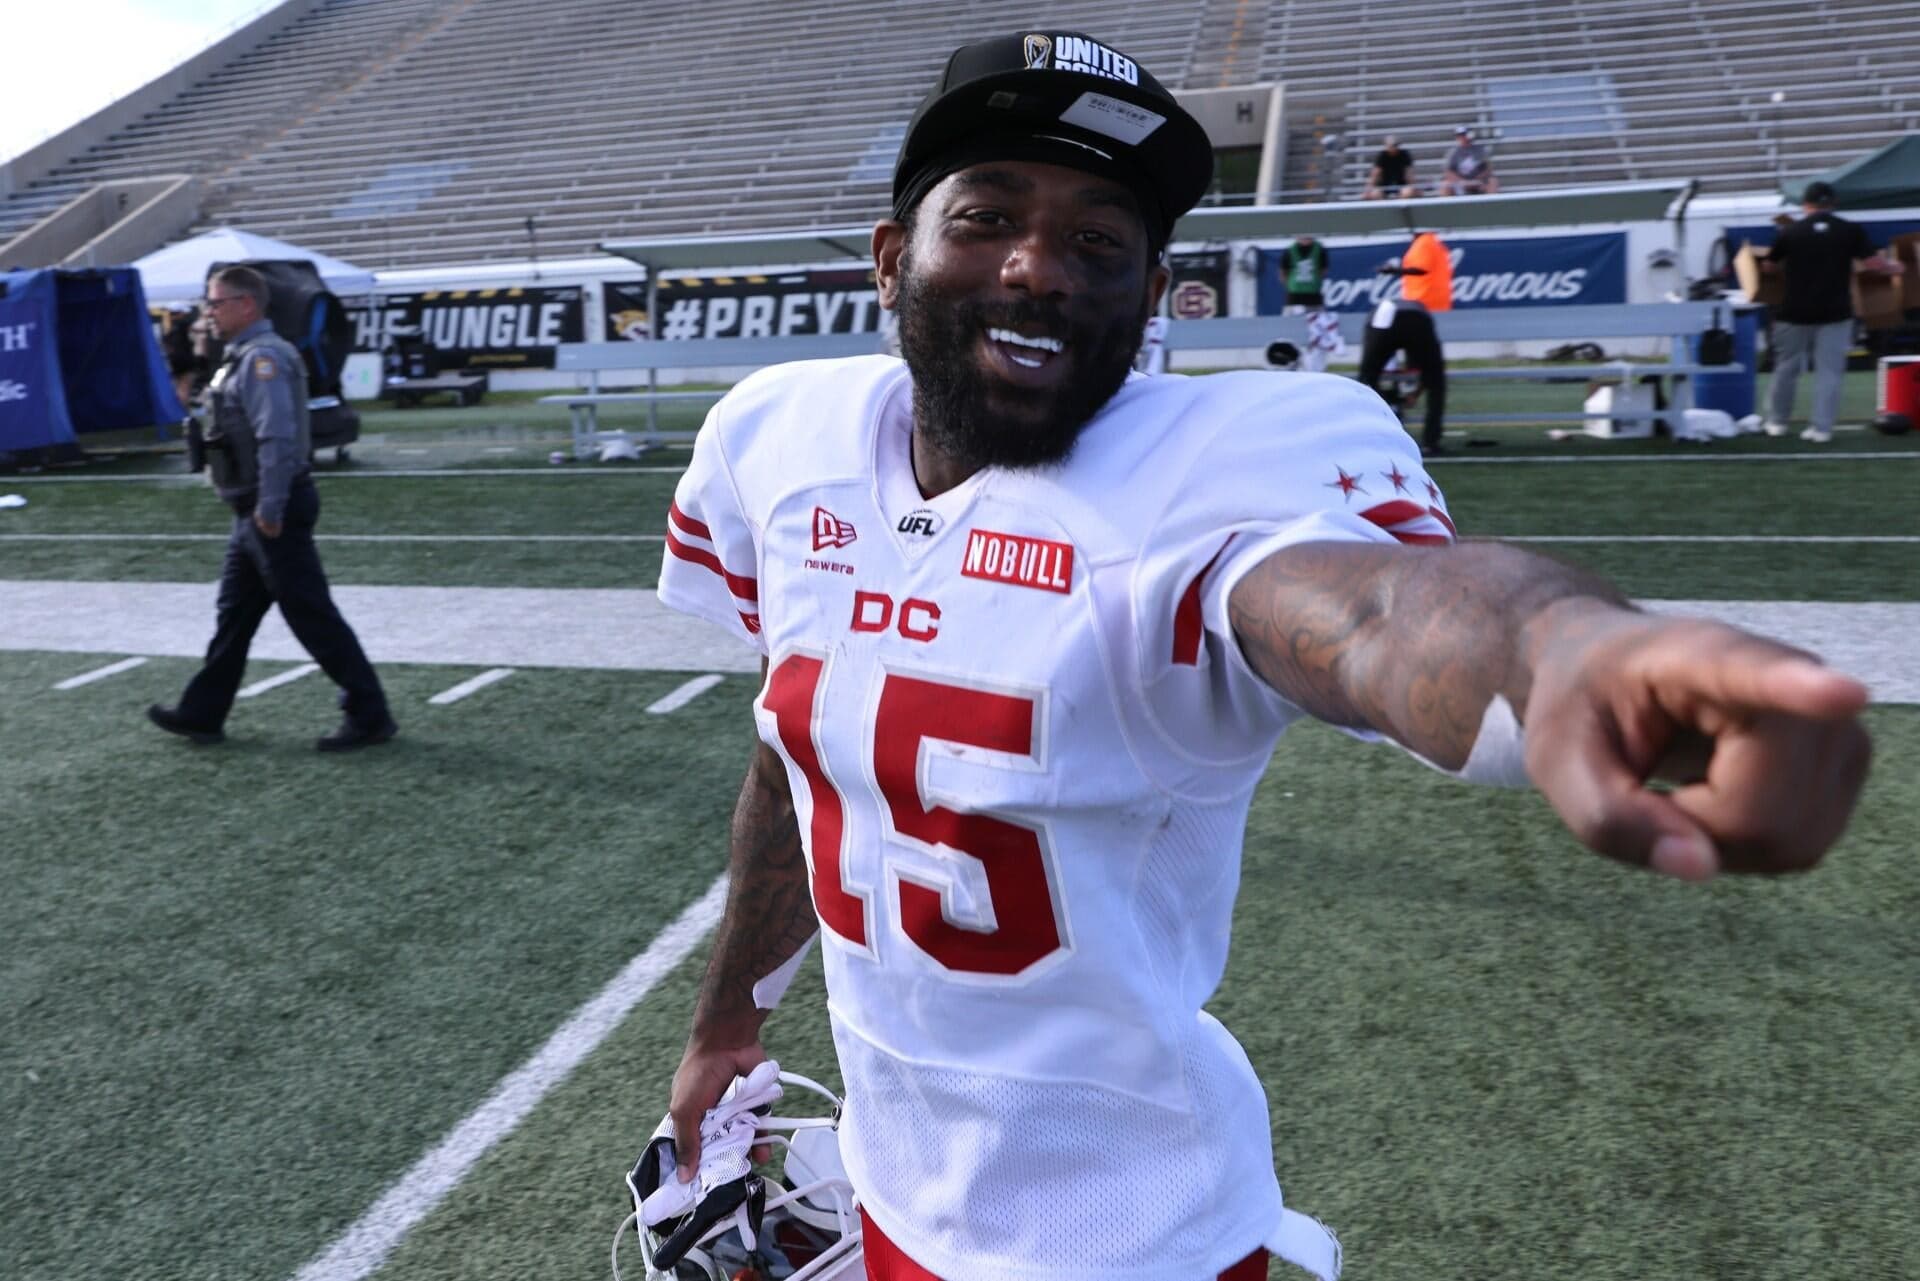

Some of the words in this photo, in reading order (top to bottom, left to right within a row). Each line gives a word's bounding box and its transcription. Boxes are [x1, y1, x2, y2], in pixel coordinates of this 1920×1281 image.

[1055, 36, 1138, 86] UNITED
[1236, 101, 1254, 124] H
[897, 514, 935, 537] UFL
[965, 534, 1067, 588] NOBULL
[850, 590, 942, 643] DC
[757, 648, 1074, 984] 15
